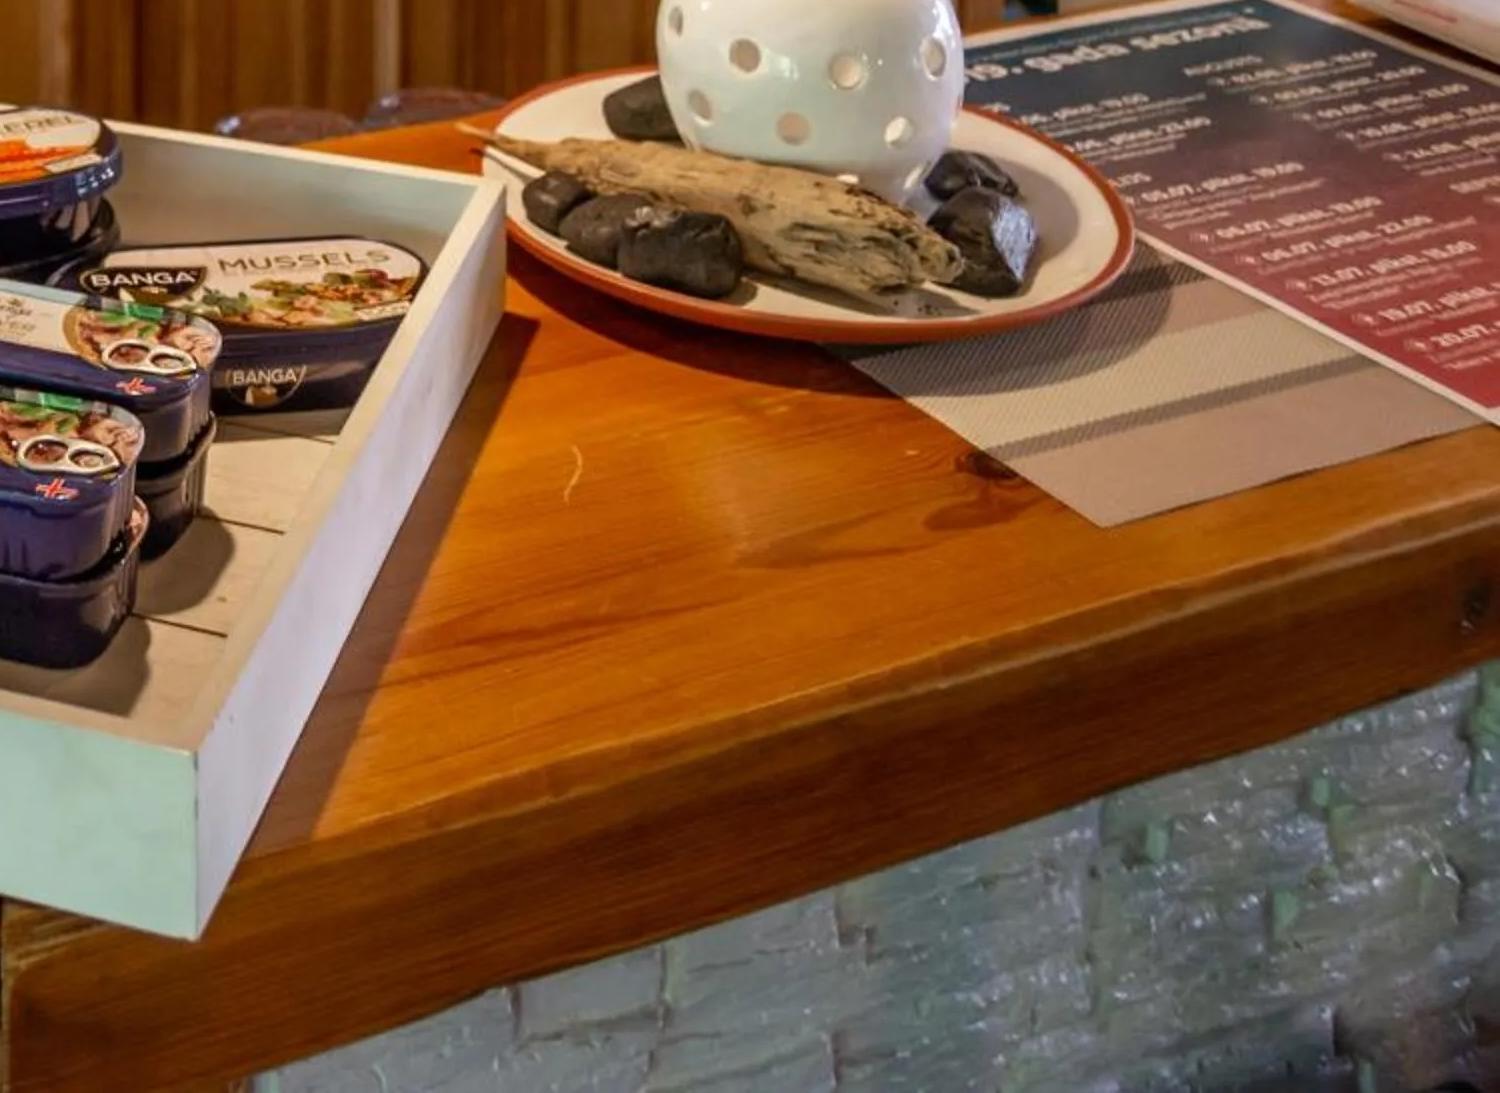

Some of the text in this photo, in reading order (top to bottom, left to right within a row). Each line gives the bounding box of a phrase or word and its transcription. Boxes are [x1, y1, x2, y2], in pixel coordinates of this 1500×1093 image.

[1023, 44, 1131, 73] gada
[217, 249, 391, 275] MUSSELS
[90, 269, 194, 290] BANGA
[231, 367, 298, 386] BANGA
